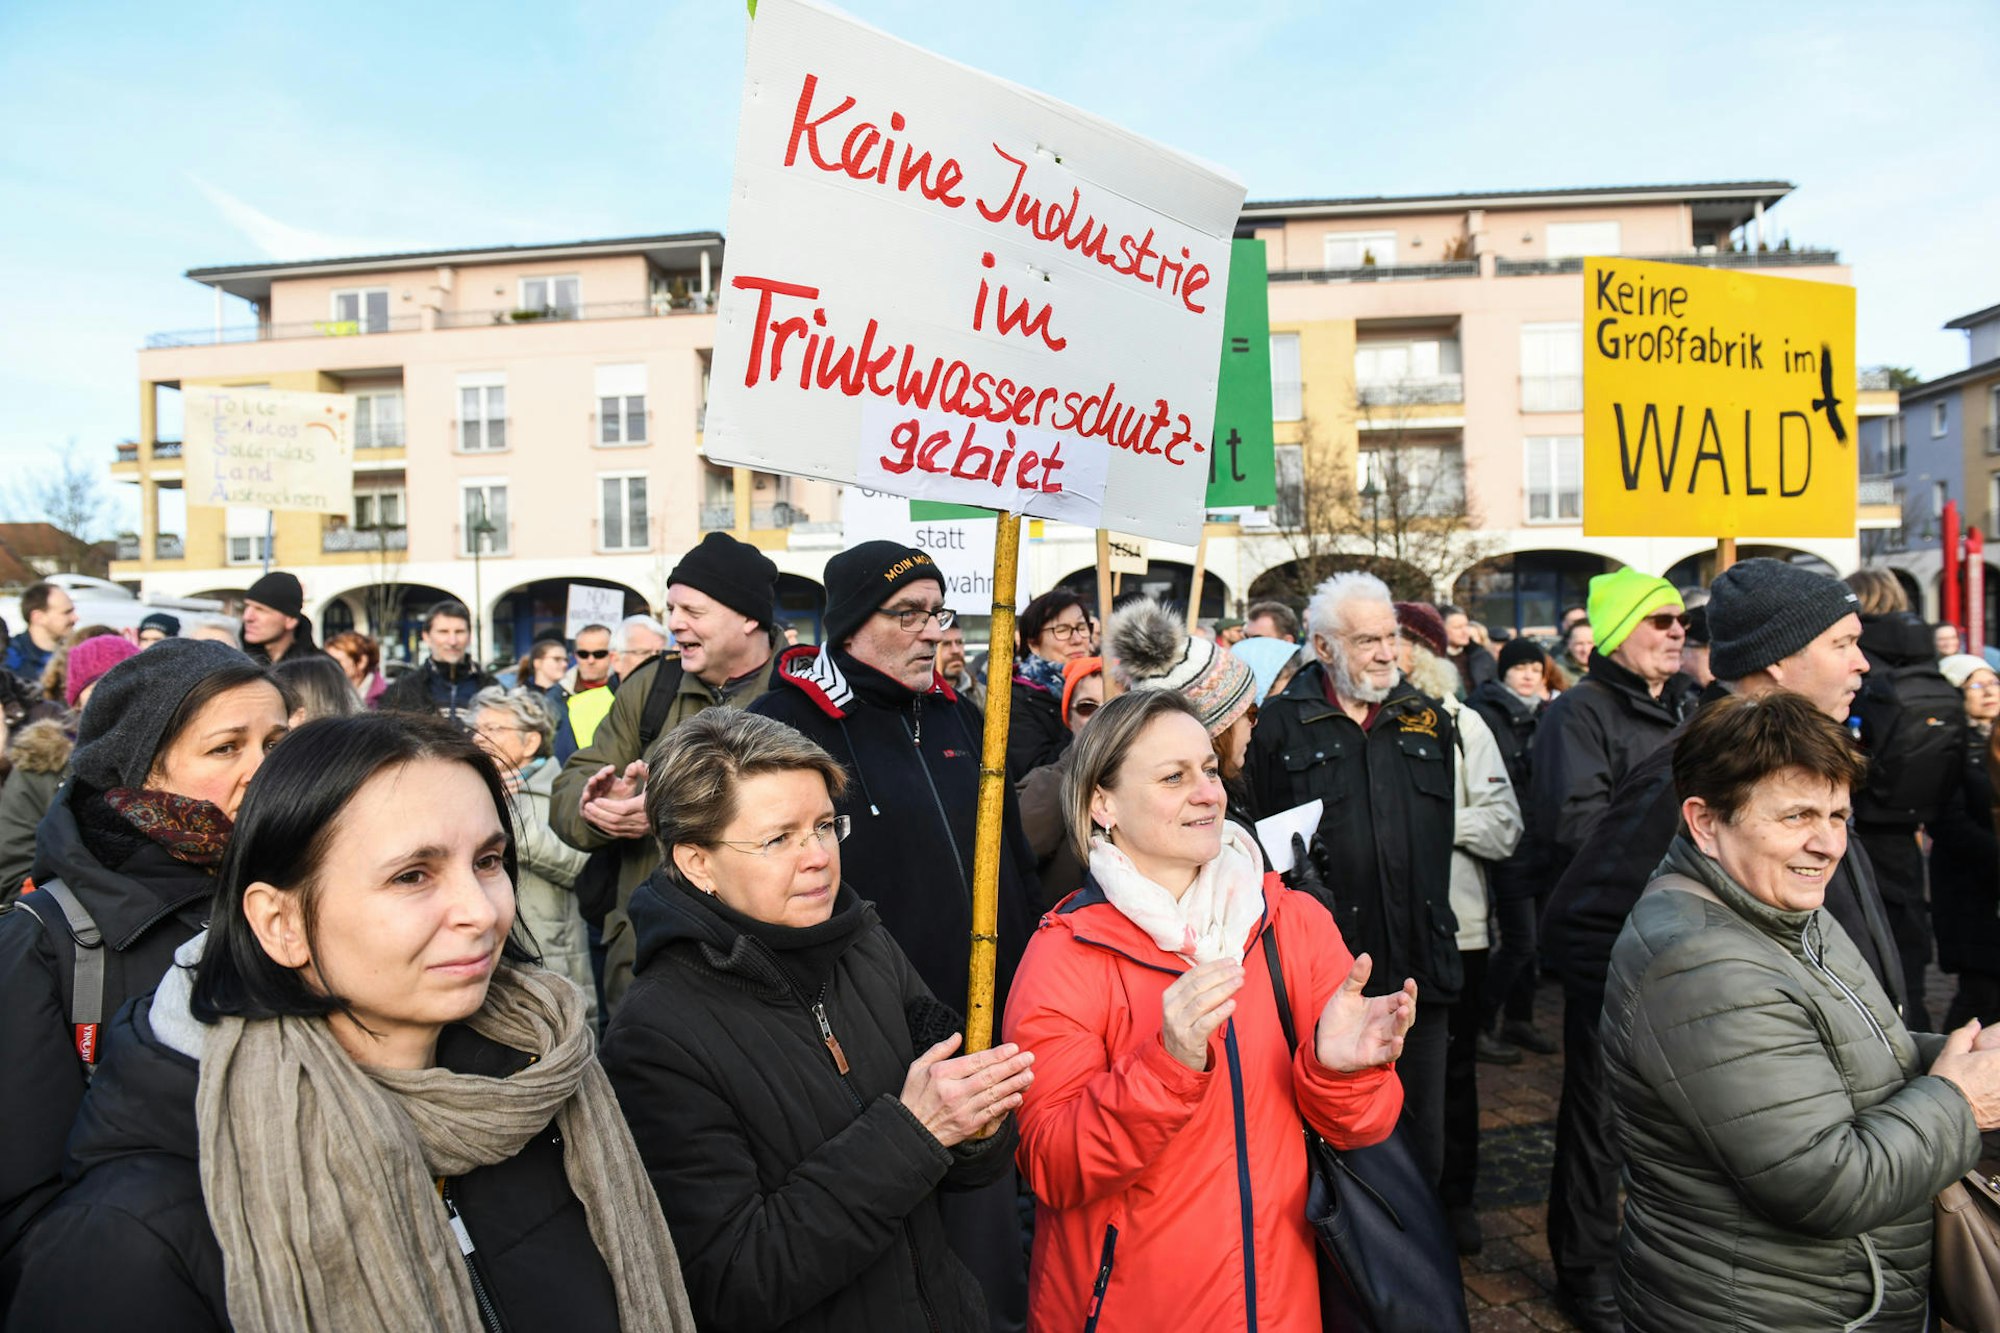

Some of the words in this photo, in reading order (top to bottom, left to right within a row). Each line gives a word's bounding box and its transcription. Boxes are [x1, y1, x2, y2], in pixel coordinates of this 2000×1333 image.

[784, 73, 965, 209] Keine
[972, 142, 1210, 314] Industrie
[972, 251, 1067, 352] im
[1597, 268, 1688, 318] Keine
[1597, 317, 1764, 369] Großfabrik
[1784, 338, 1816, 374] im
[213, 460, 274, 482] Land
[879, 419, 1065, 494] gebiet
[1613, 402, 1812, 498] WALD
[916, 526, 965, 550] statt
[884, 557, 914, 583] MOIN
